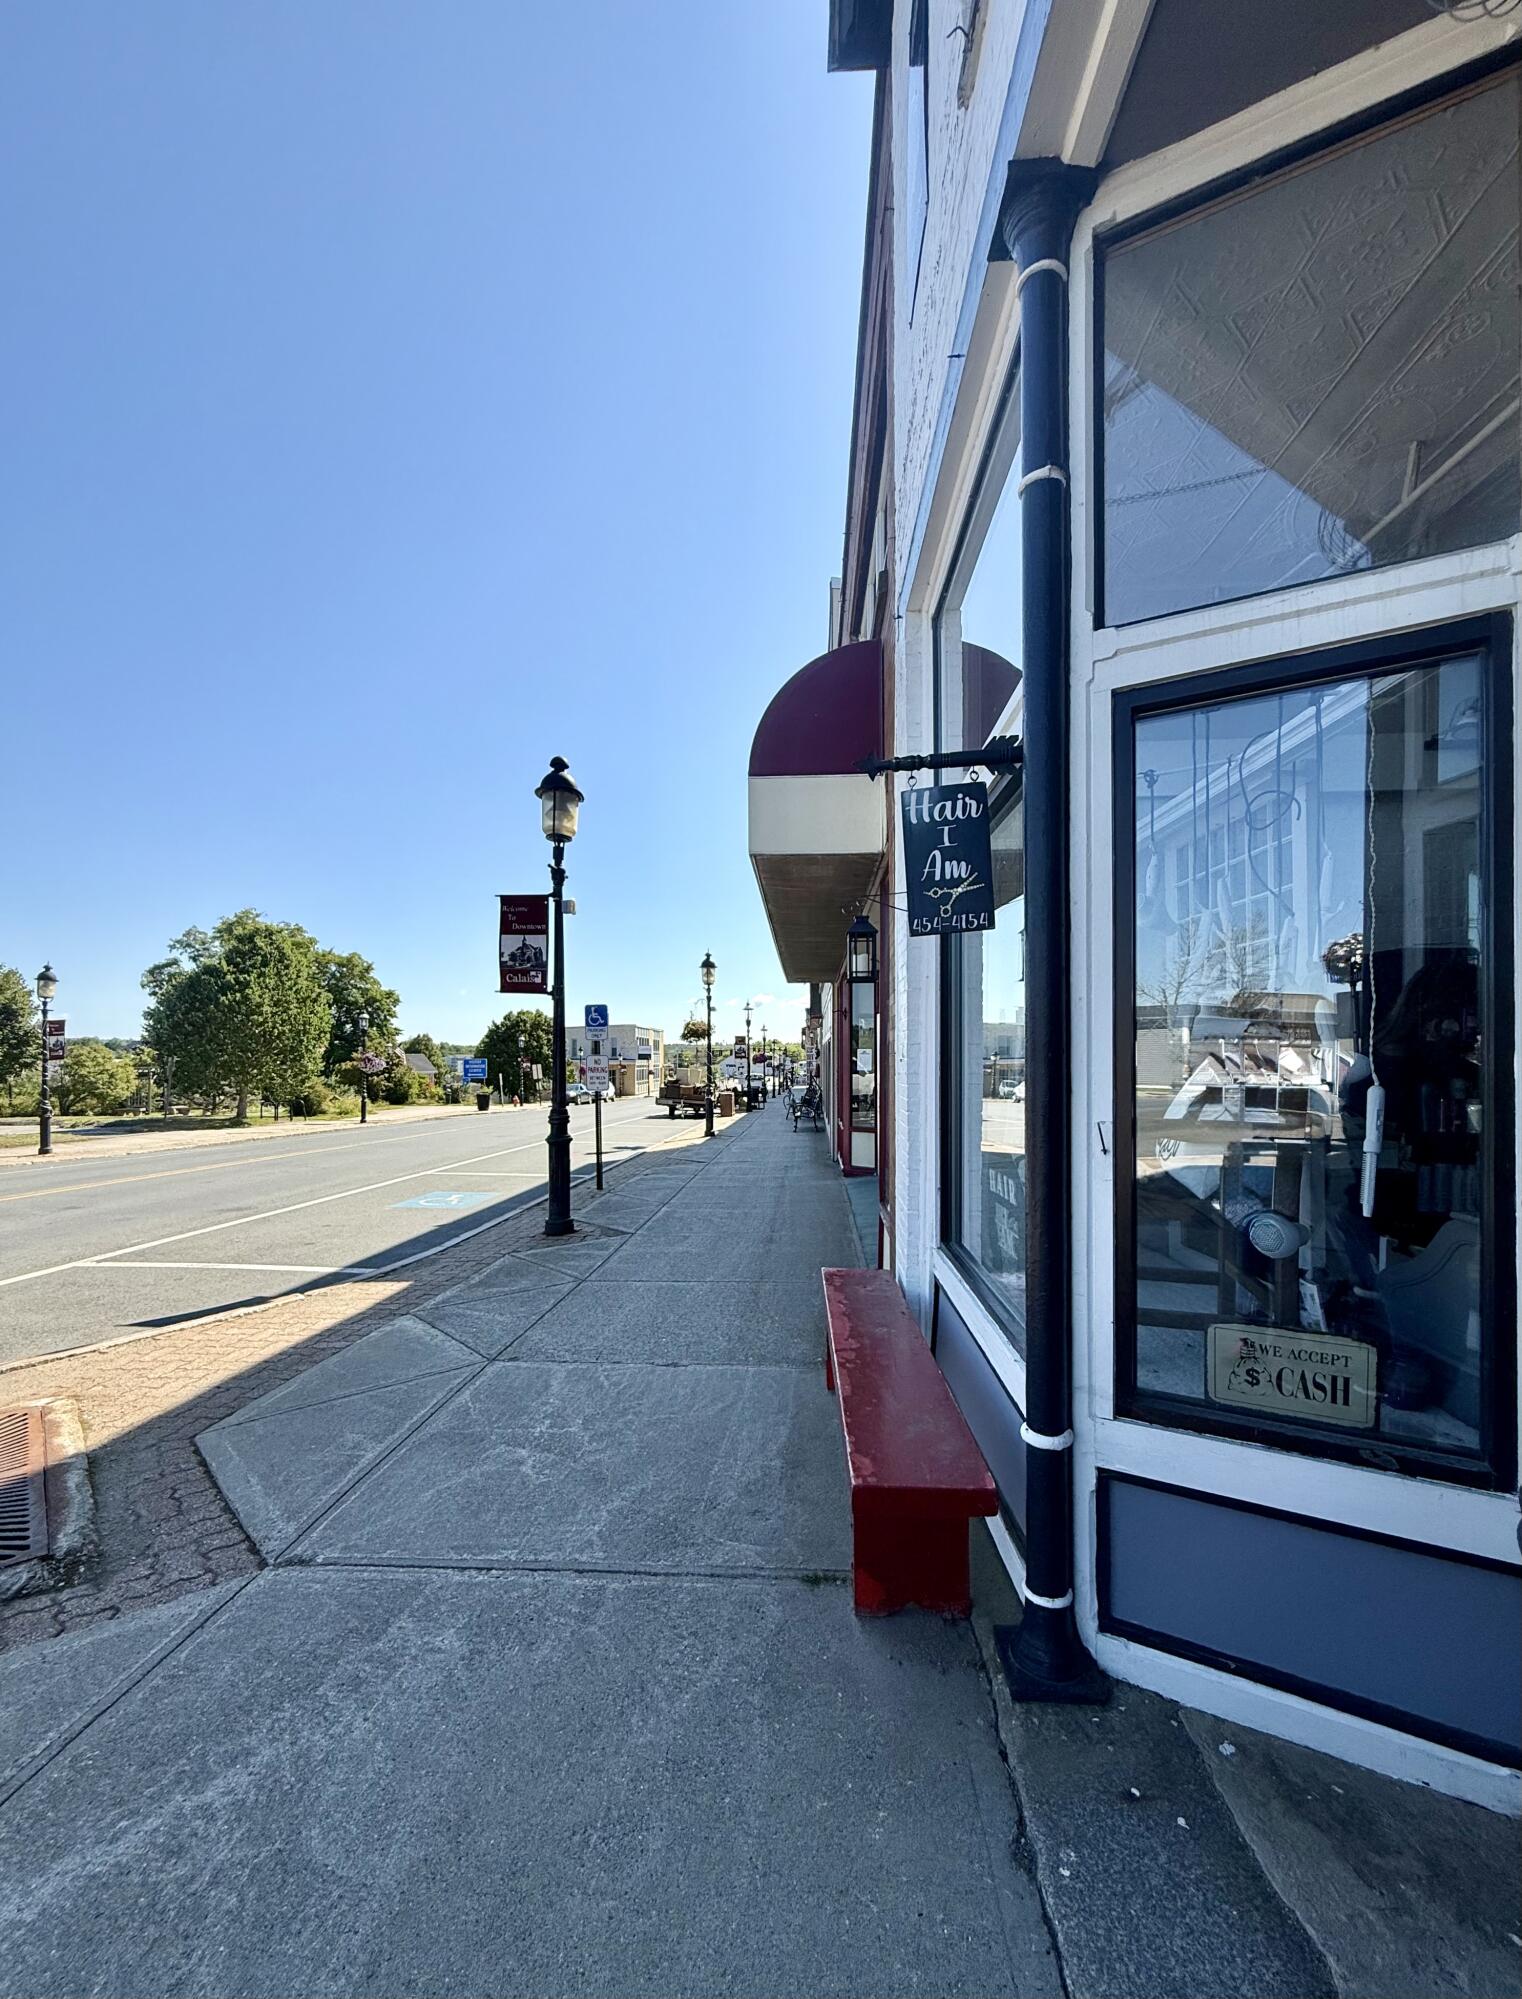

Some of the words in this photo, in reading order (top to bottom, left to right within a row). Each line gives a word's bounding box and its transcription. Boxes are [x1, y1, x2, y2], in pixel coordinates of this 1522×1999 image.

[905, 790, 983, 824] Hair
[936, 824, 958, 848] I
[920, 849, 972, 882] Am
[912, 912, 989, 934] 454-4154
[505, 973, 535, 983] Calais
[587, 1066, 608, 1074] PARKING
[988, 1167, 1017, 1206] HAIR
[1258, 1343, 1283, 1358] WE
[1287, 1348, 1352, 1368] ACCEPT
[1275, 1366, 1353, 1407] CASH
